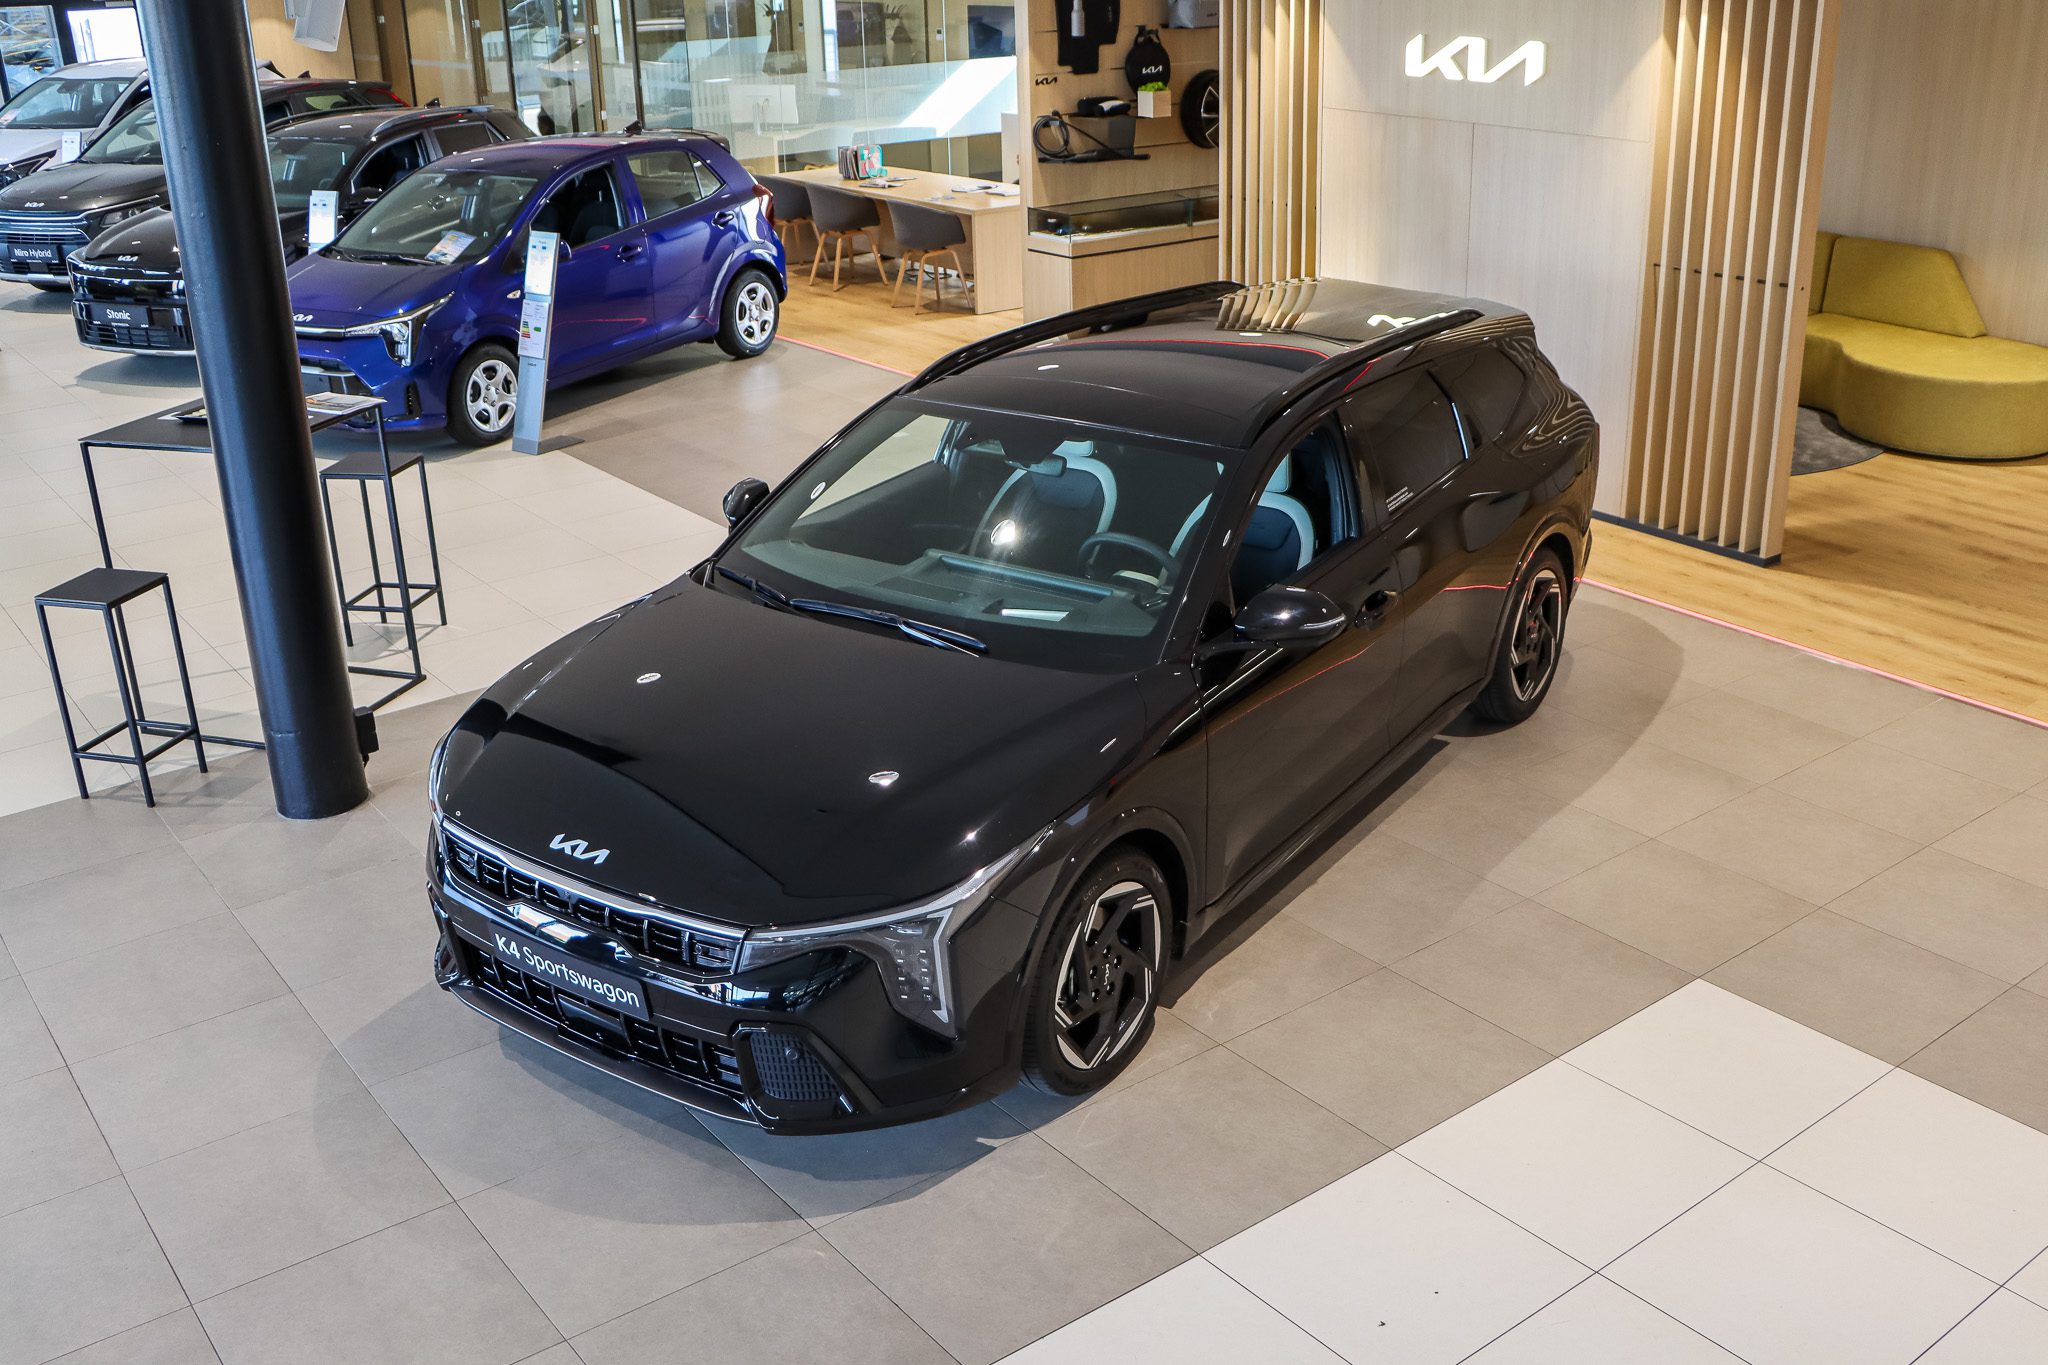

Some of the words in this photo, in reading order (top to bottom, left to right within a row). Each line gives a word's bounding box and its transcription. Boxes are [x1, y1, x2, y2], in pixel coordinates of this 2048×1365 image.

[1405, 33, 1547, 87] KIA
[1142, 65, 1162, 74] KIA
[1035, 76, 1058, 86] KIA
[14, 248, 29, 257] Niro
[29, 249, 52, 259] Hybrid
[106, 308, 131, 320] Stonic
[550, 833, 610, 865] KIA
[494, 933, 521, 960] K4
[522, 946, 640, 1008] Sportswagon
